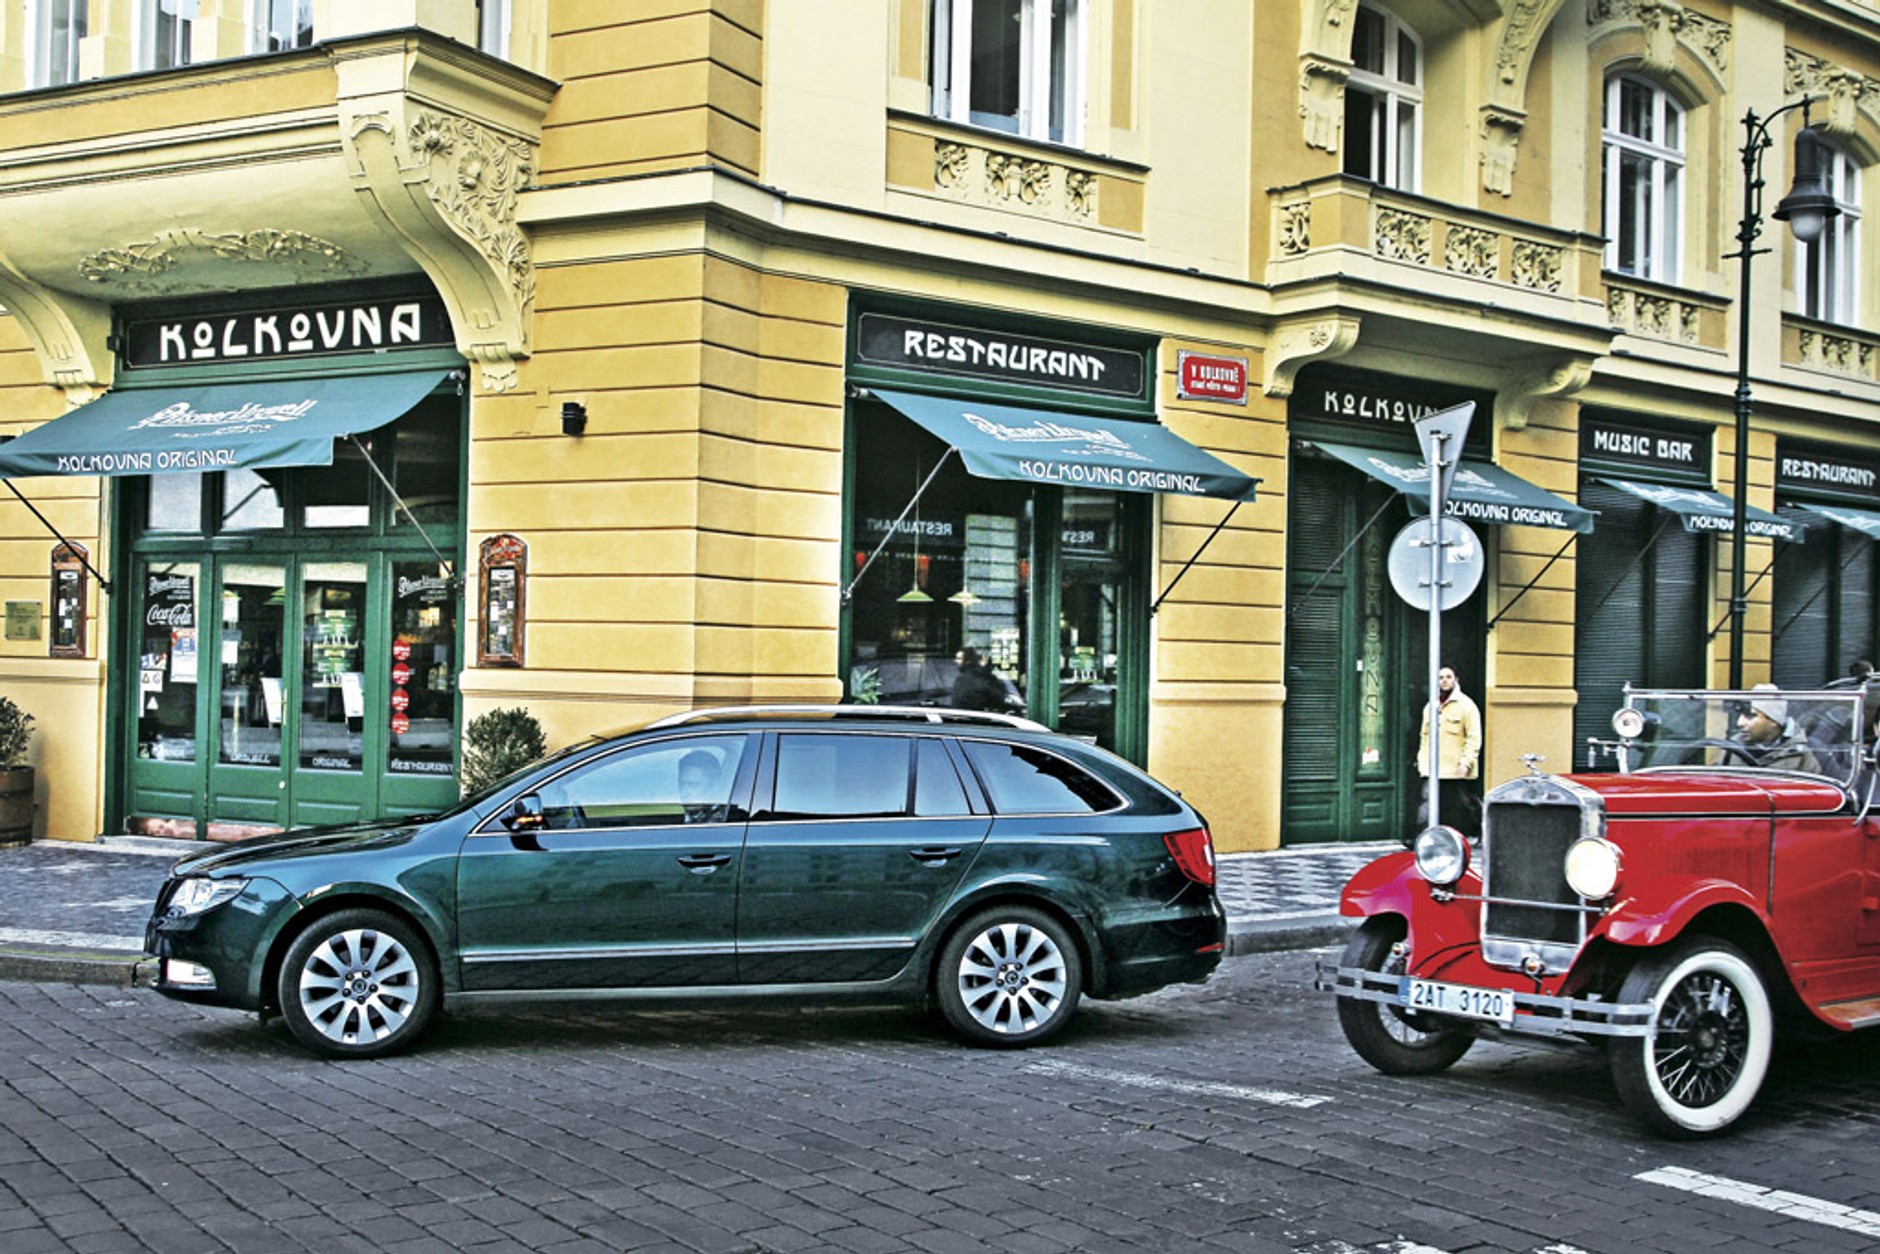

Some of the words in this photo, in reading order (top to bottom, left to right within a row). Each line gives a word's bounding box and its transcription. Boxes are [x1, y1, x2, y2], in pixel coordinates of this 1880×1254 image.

[160, 303, 421, 361] KOLKOVNA
[904, 330, 1105, 381] RESTAURANT
[57, 452, 151, 472] KOLKOVNA
[157, 449, 239, 469] ORIGINAL
[1594, 430, 1651, 456] MUSIC
[1656, 439, 1693, 462] BAR
[1018, 460, 1123, 485] KOLKOVNA
[1127, 469, 1206, 493] ORIGINAL
[1782, 458, 1876, 487] RESTAURANT
[1444, 500, 1509, 521] OLKOVNA
[1414, 983, 1446, 1009] 2AT
[1459, 989, 1503, 1017] 3120
